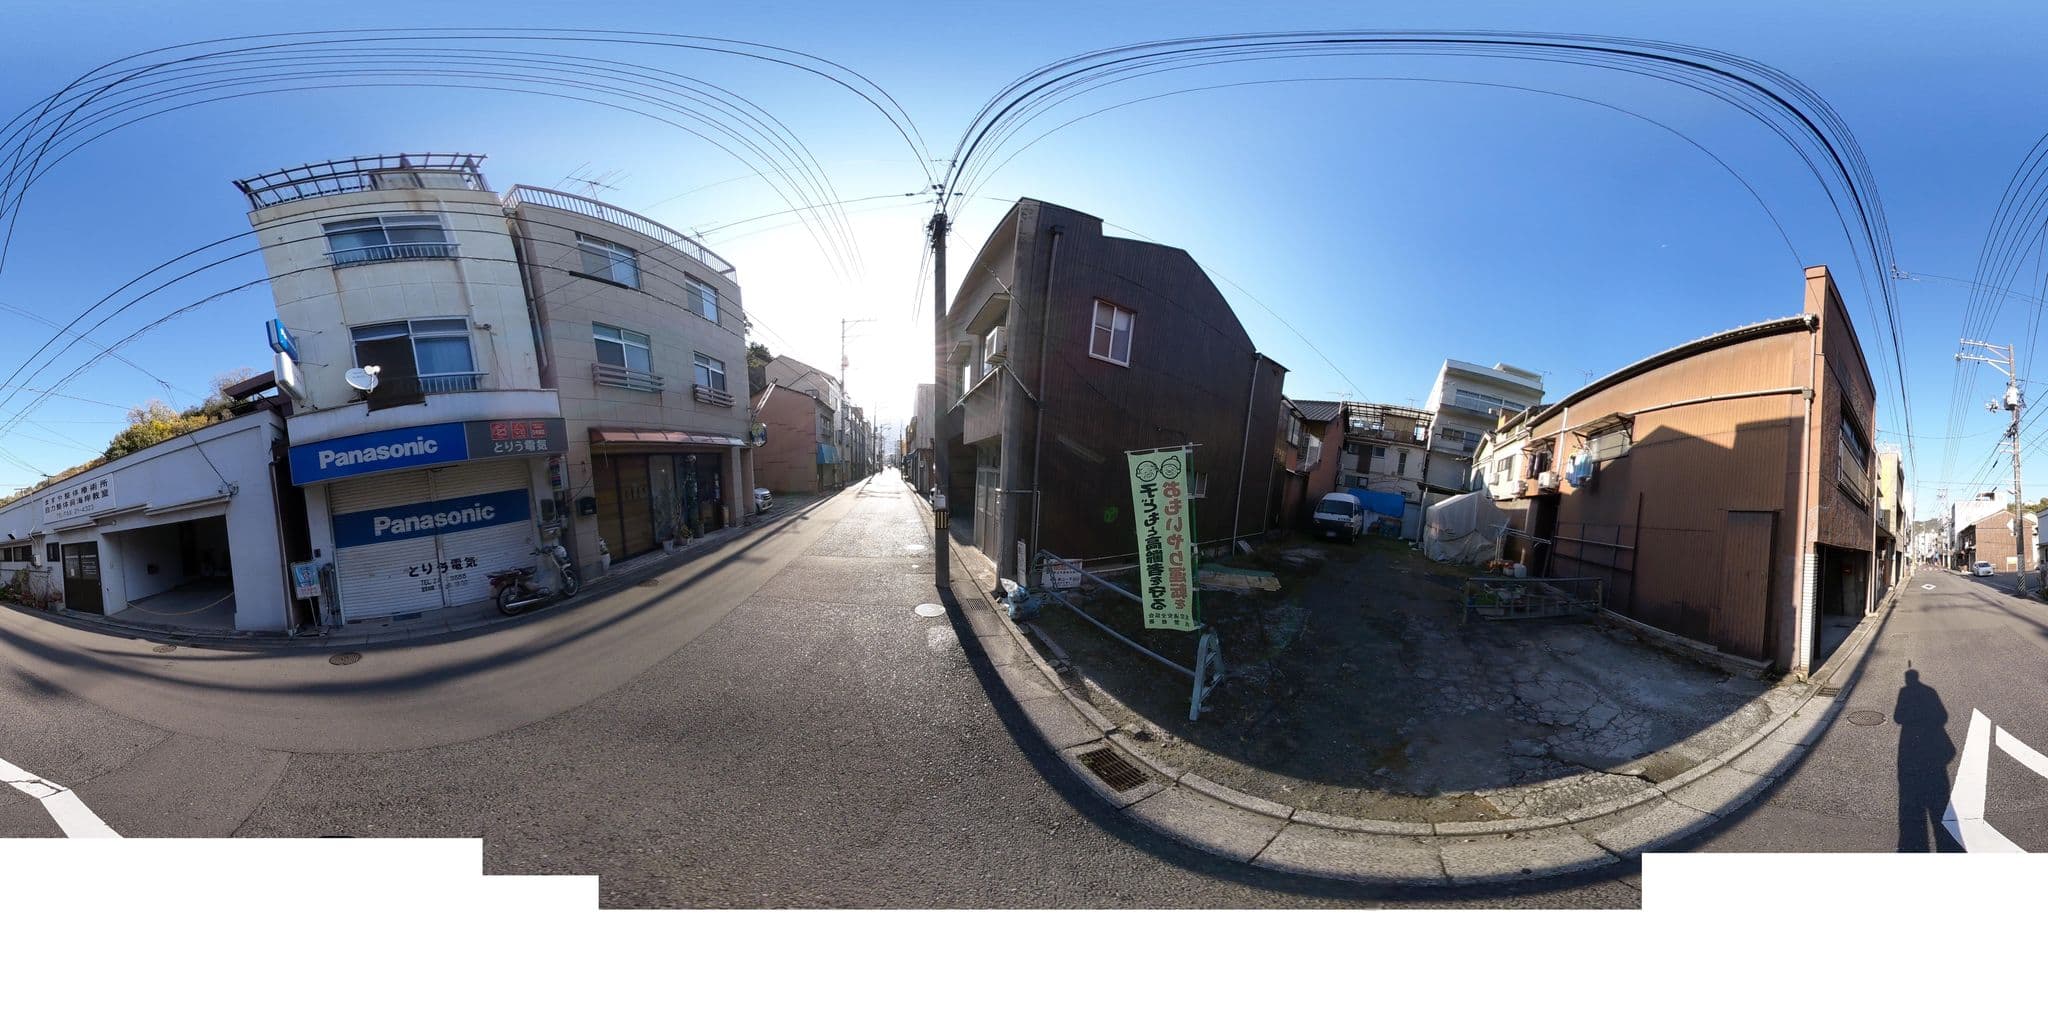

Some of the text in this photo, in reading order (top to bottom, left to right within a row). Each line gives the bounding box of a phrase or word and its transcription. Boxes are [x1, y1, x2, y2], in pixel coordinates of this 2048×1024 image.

[319, 436, 438, 469] Panasonic
[493, 439, 548, 453] とりう電気
[373, 502, 495, 537] Panasonic
[408, 556, 478, 578] とりう電気
